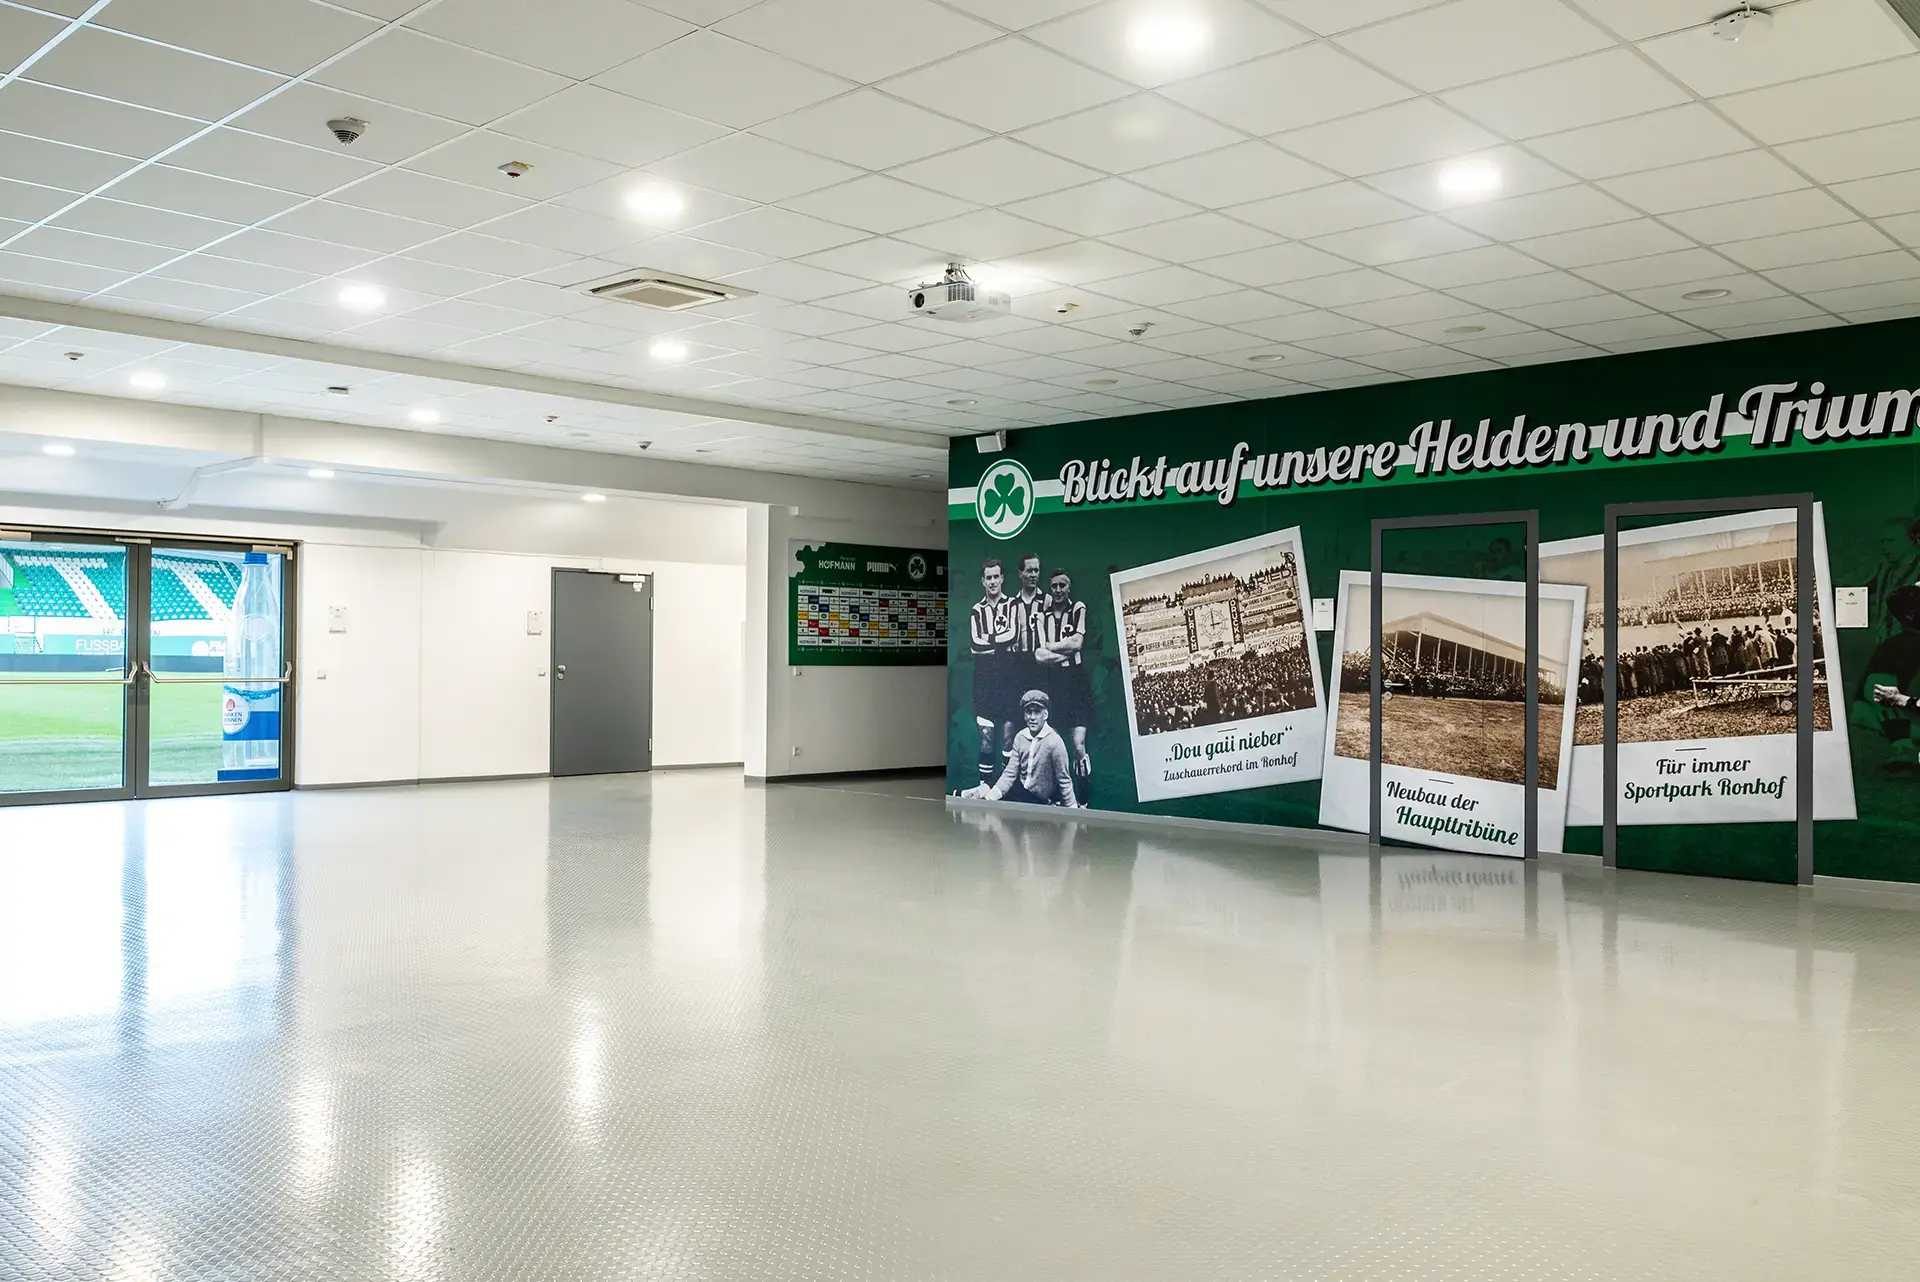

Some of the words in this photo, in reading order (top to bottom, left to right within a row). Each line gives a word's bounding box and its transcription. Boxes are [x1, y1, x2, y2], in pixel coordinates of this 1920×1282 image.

[1060, 456, 1168, 504] Blickt
[1176, 442, 1249, 505] auf
[1253, 441, 1398, 487] unsere
[1408, 418, 1589, 474] Helden
[1602, 393, 1726, 458] und
[1738, 381, 1920, 445] Trium
[818, 560, 856, 571] HOFMANN
[867, 562, 889, 573] PUMA
[1205, 735, 1235, 761] gaii
[1164, 761, 1243, 781] Zuschauerrekord
[1246, 760, 1259, 770] im
[1260, 752, 1298, 768] Ronhof
[1656, 758, 1687, 775] Für
[1692, 758, 1751, 773] immer
[1386, 781, 1447, 807] Neubau
[1451, 794, 1480, 811] der
[1624, 780, 1713, 804] Sportpark
[1718, 776, 1788, 800] Ronhof
[1396, 806, 1519, 845] Haupttribüne
